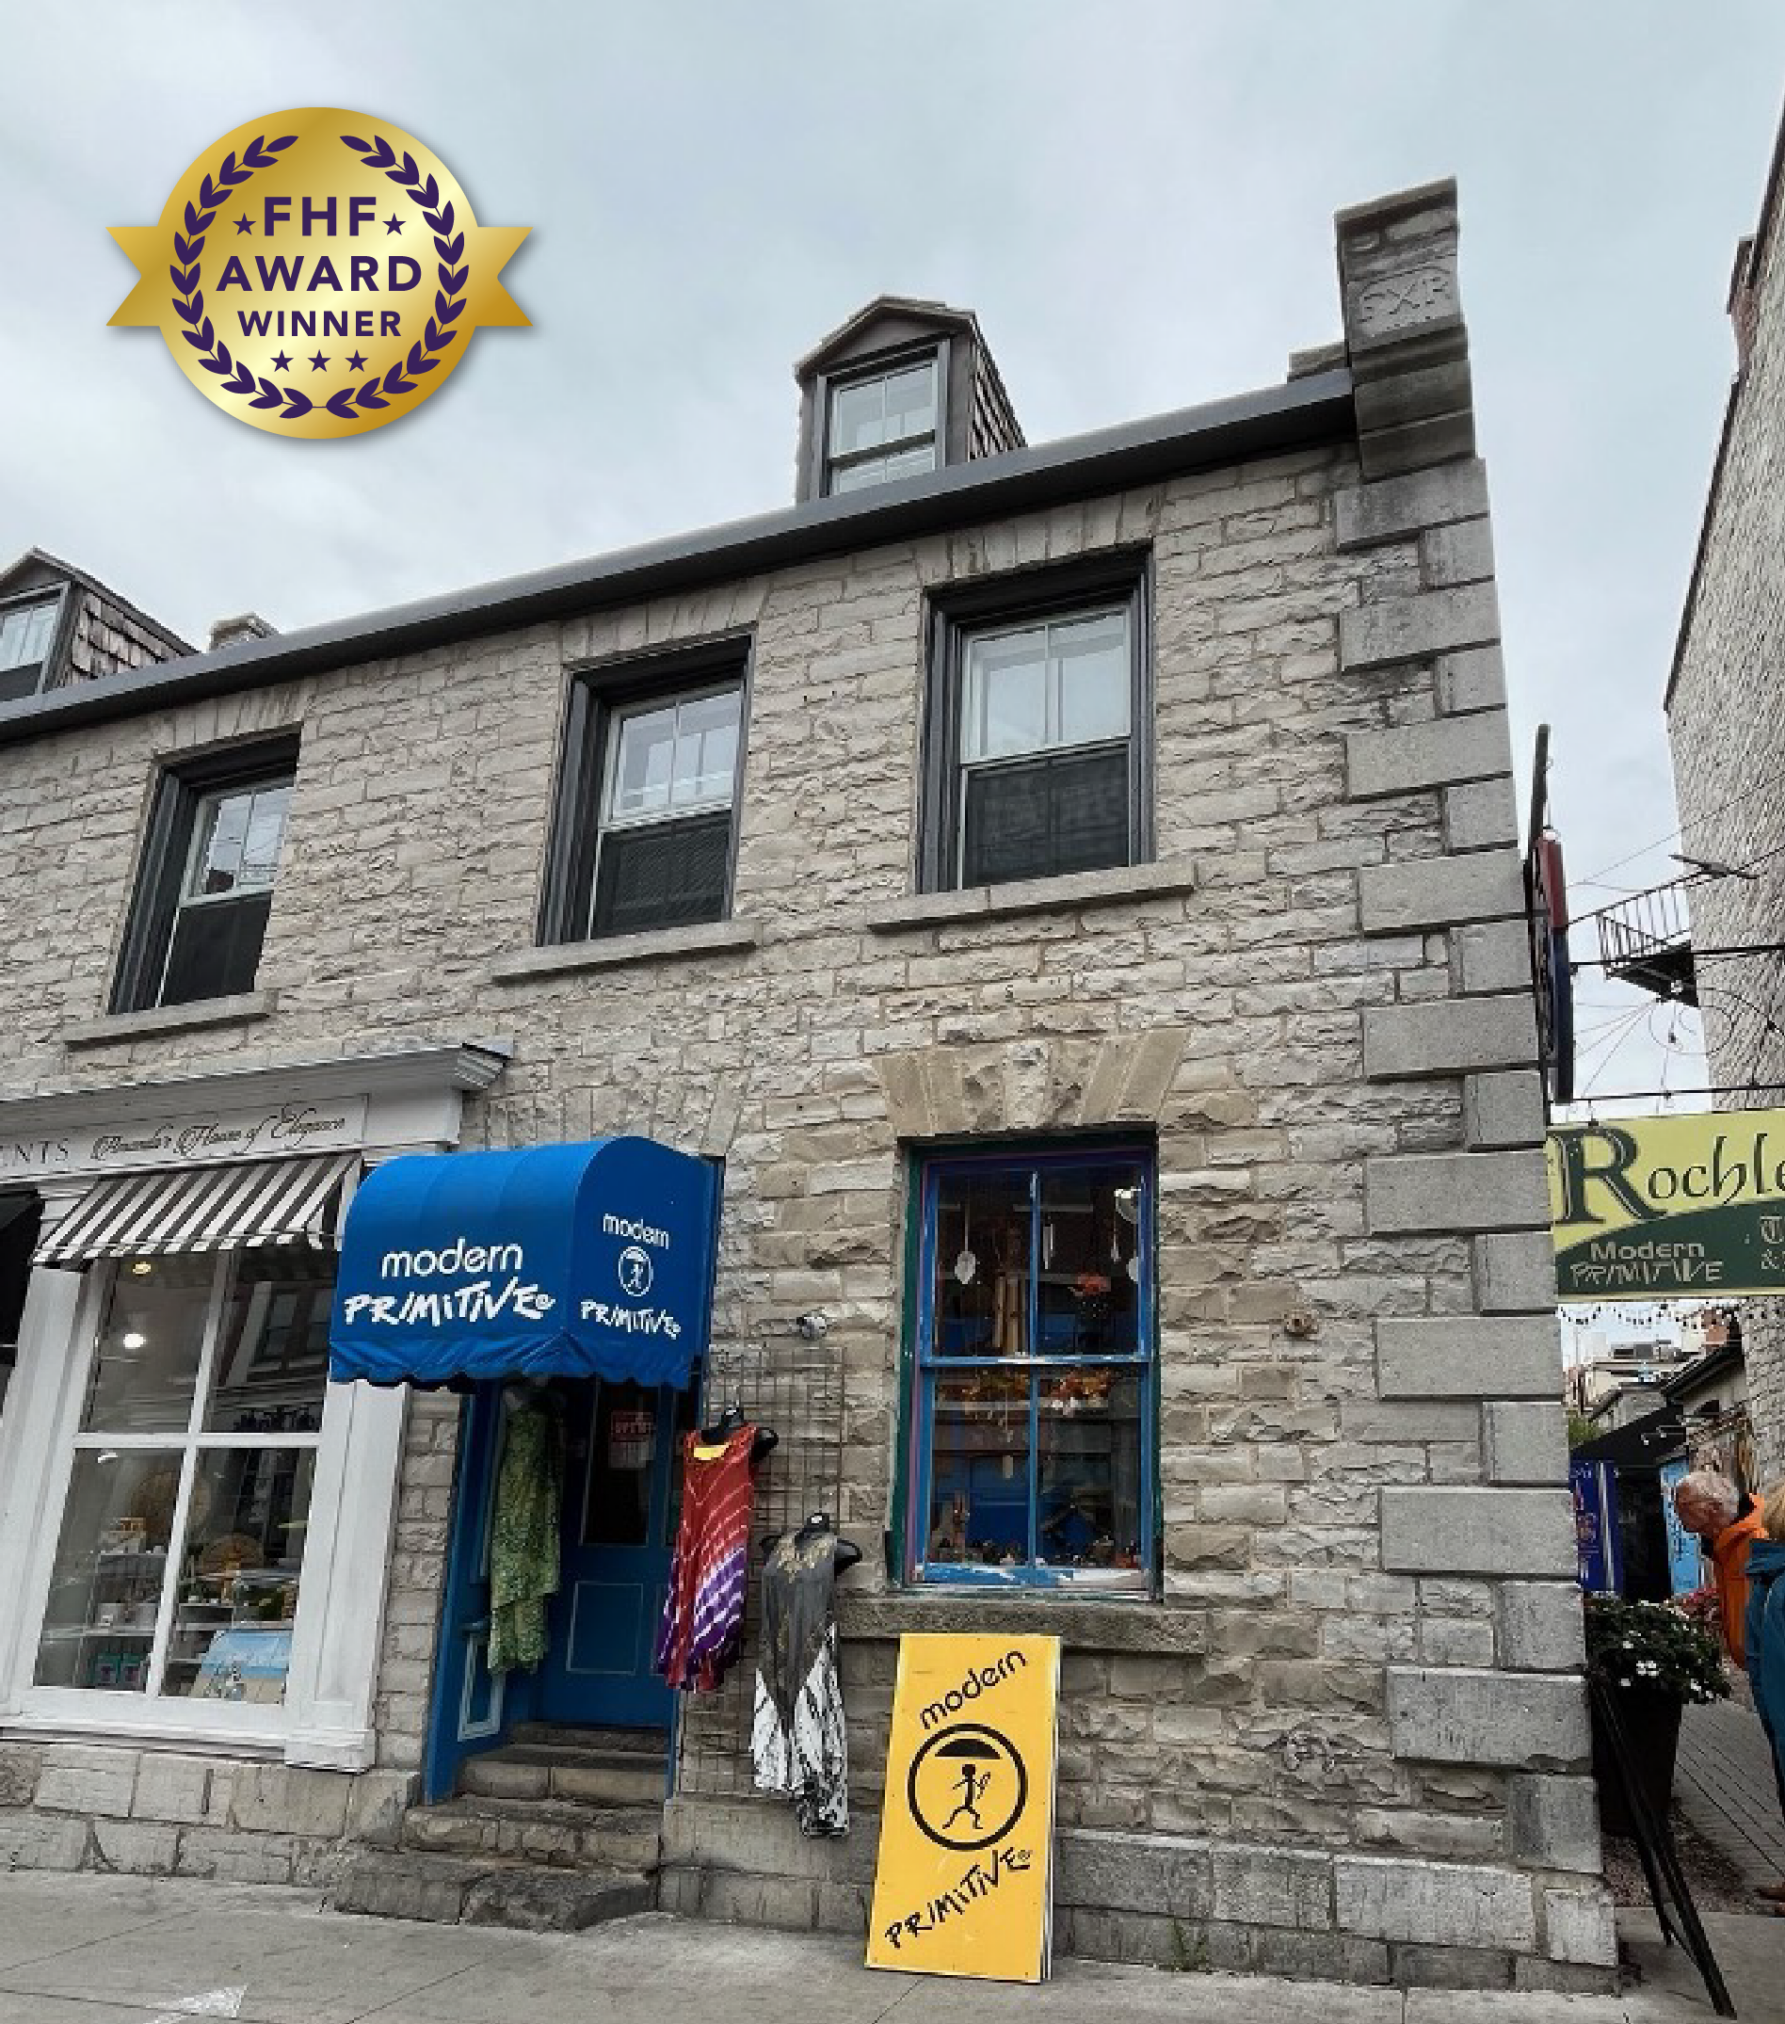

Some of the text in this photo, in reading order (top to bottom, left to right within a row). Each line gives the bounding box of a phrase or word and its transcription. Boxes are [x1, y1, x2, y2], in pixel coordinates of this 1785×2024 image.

[602, 1212, 670, 1250] modern
[381, 1236, 523, 1279] modern
[1590, 1241, 1705, 1263] Modern
[1570, 1257, 1723, 1288] PRIMITIVE
[919, 1650, 1027, 1730] modern
